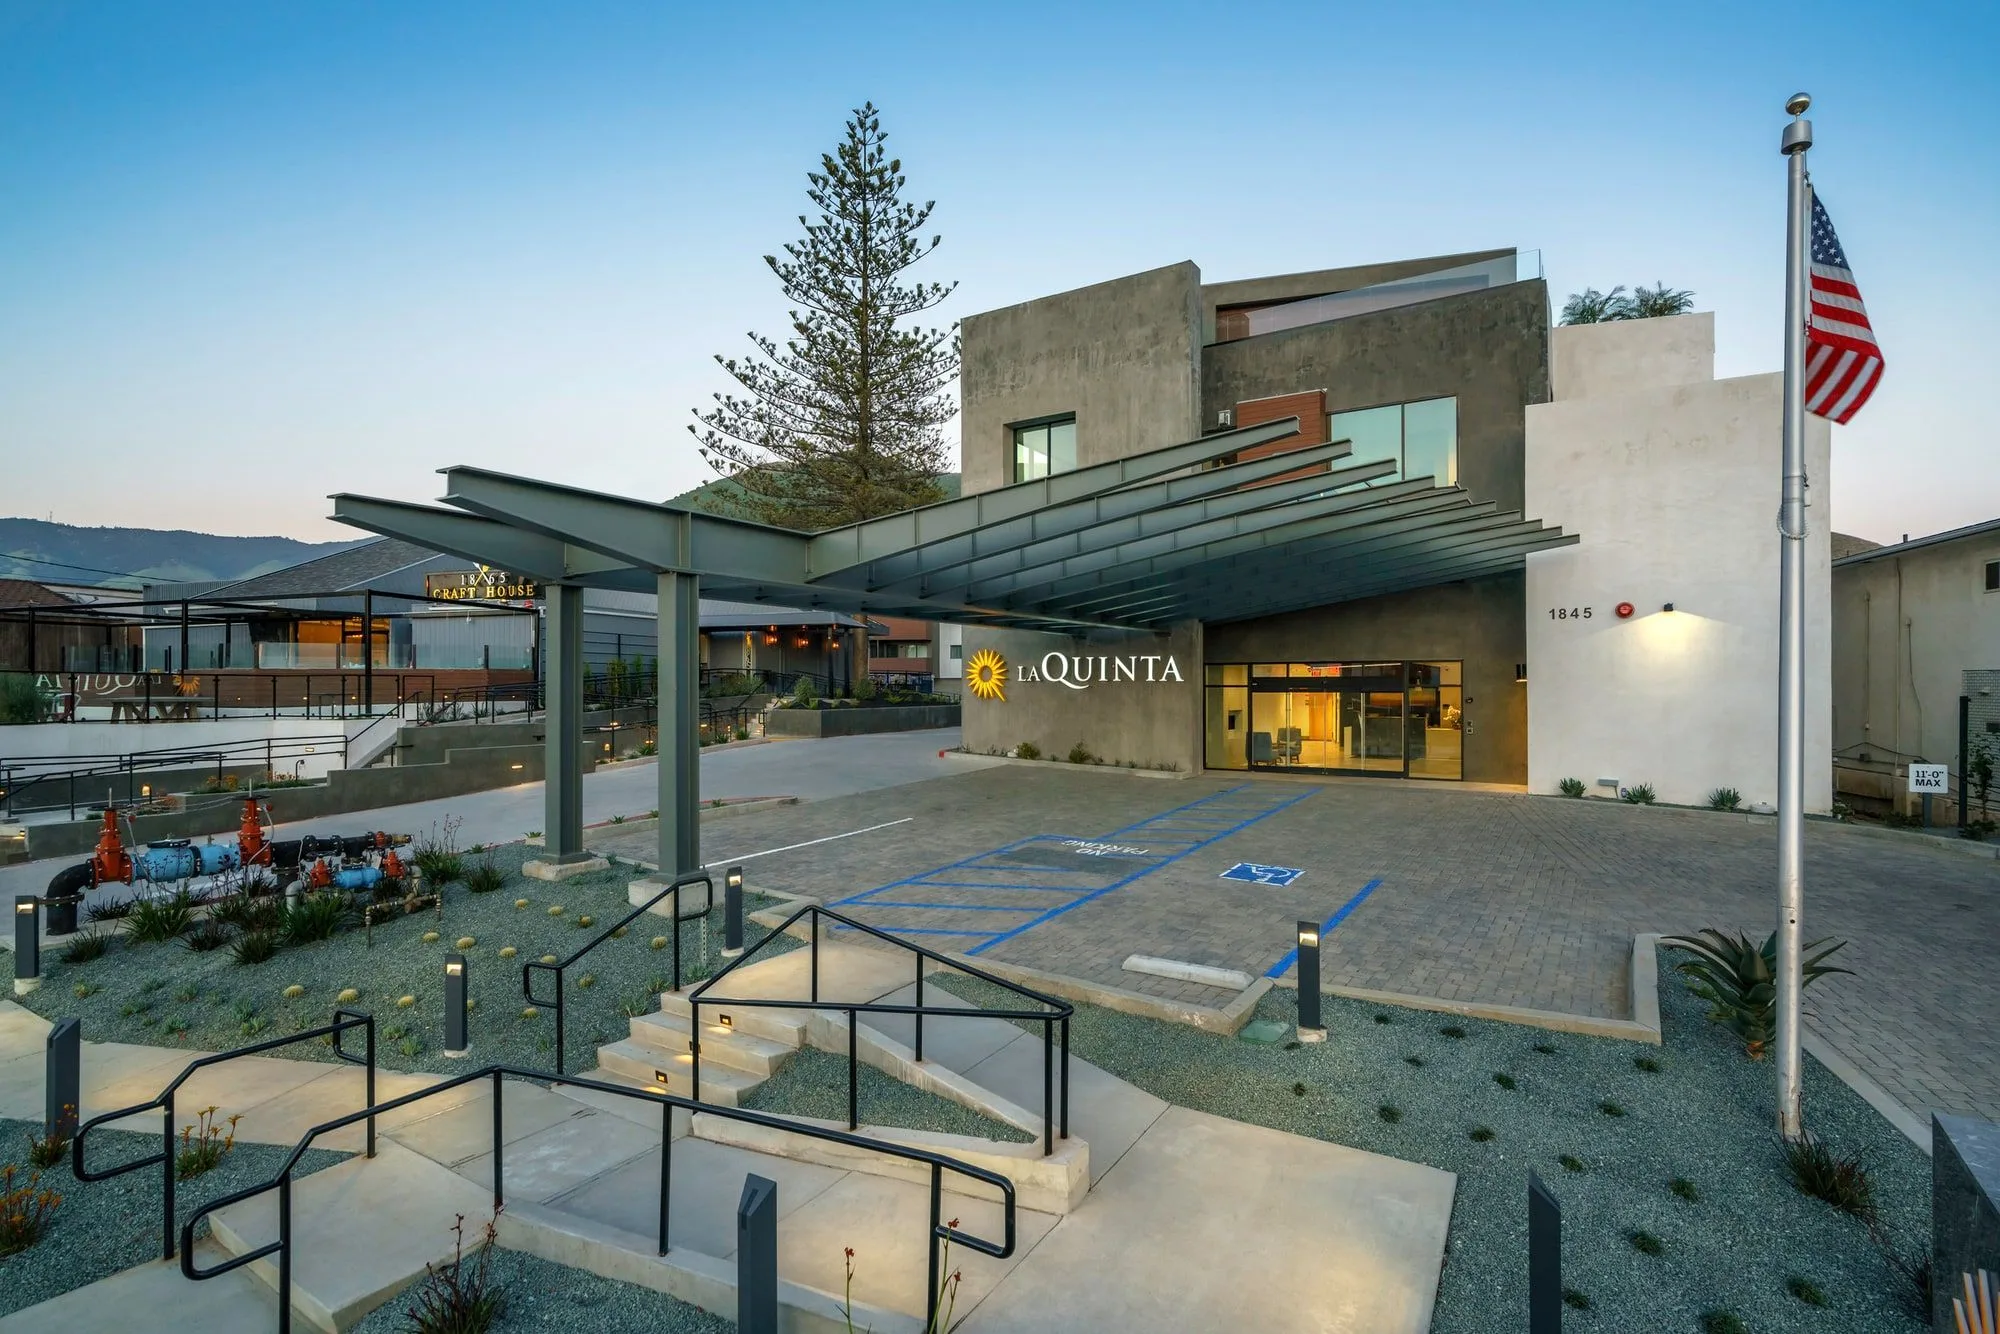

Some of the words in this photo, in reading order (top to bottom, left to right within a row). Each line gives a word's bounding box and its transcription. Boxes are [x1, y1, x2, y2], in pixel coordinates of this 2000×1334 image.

[433, 586, 476, 600] CRAFT
[486, 584, 535, 599] HOUSE
[1548, 607, 1593, 620] 1845
[1041, 651, 1185, 690] QUINTA
[1915, 779, 1941, 787] MAX
[1061, 840, 1149, 855] PARKING
[1076, 848, 1109, 856] NO
